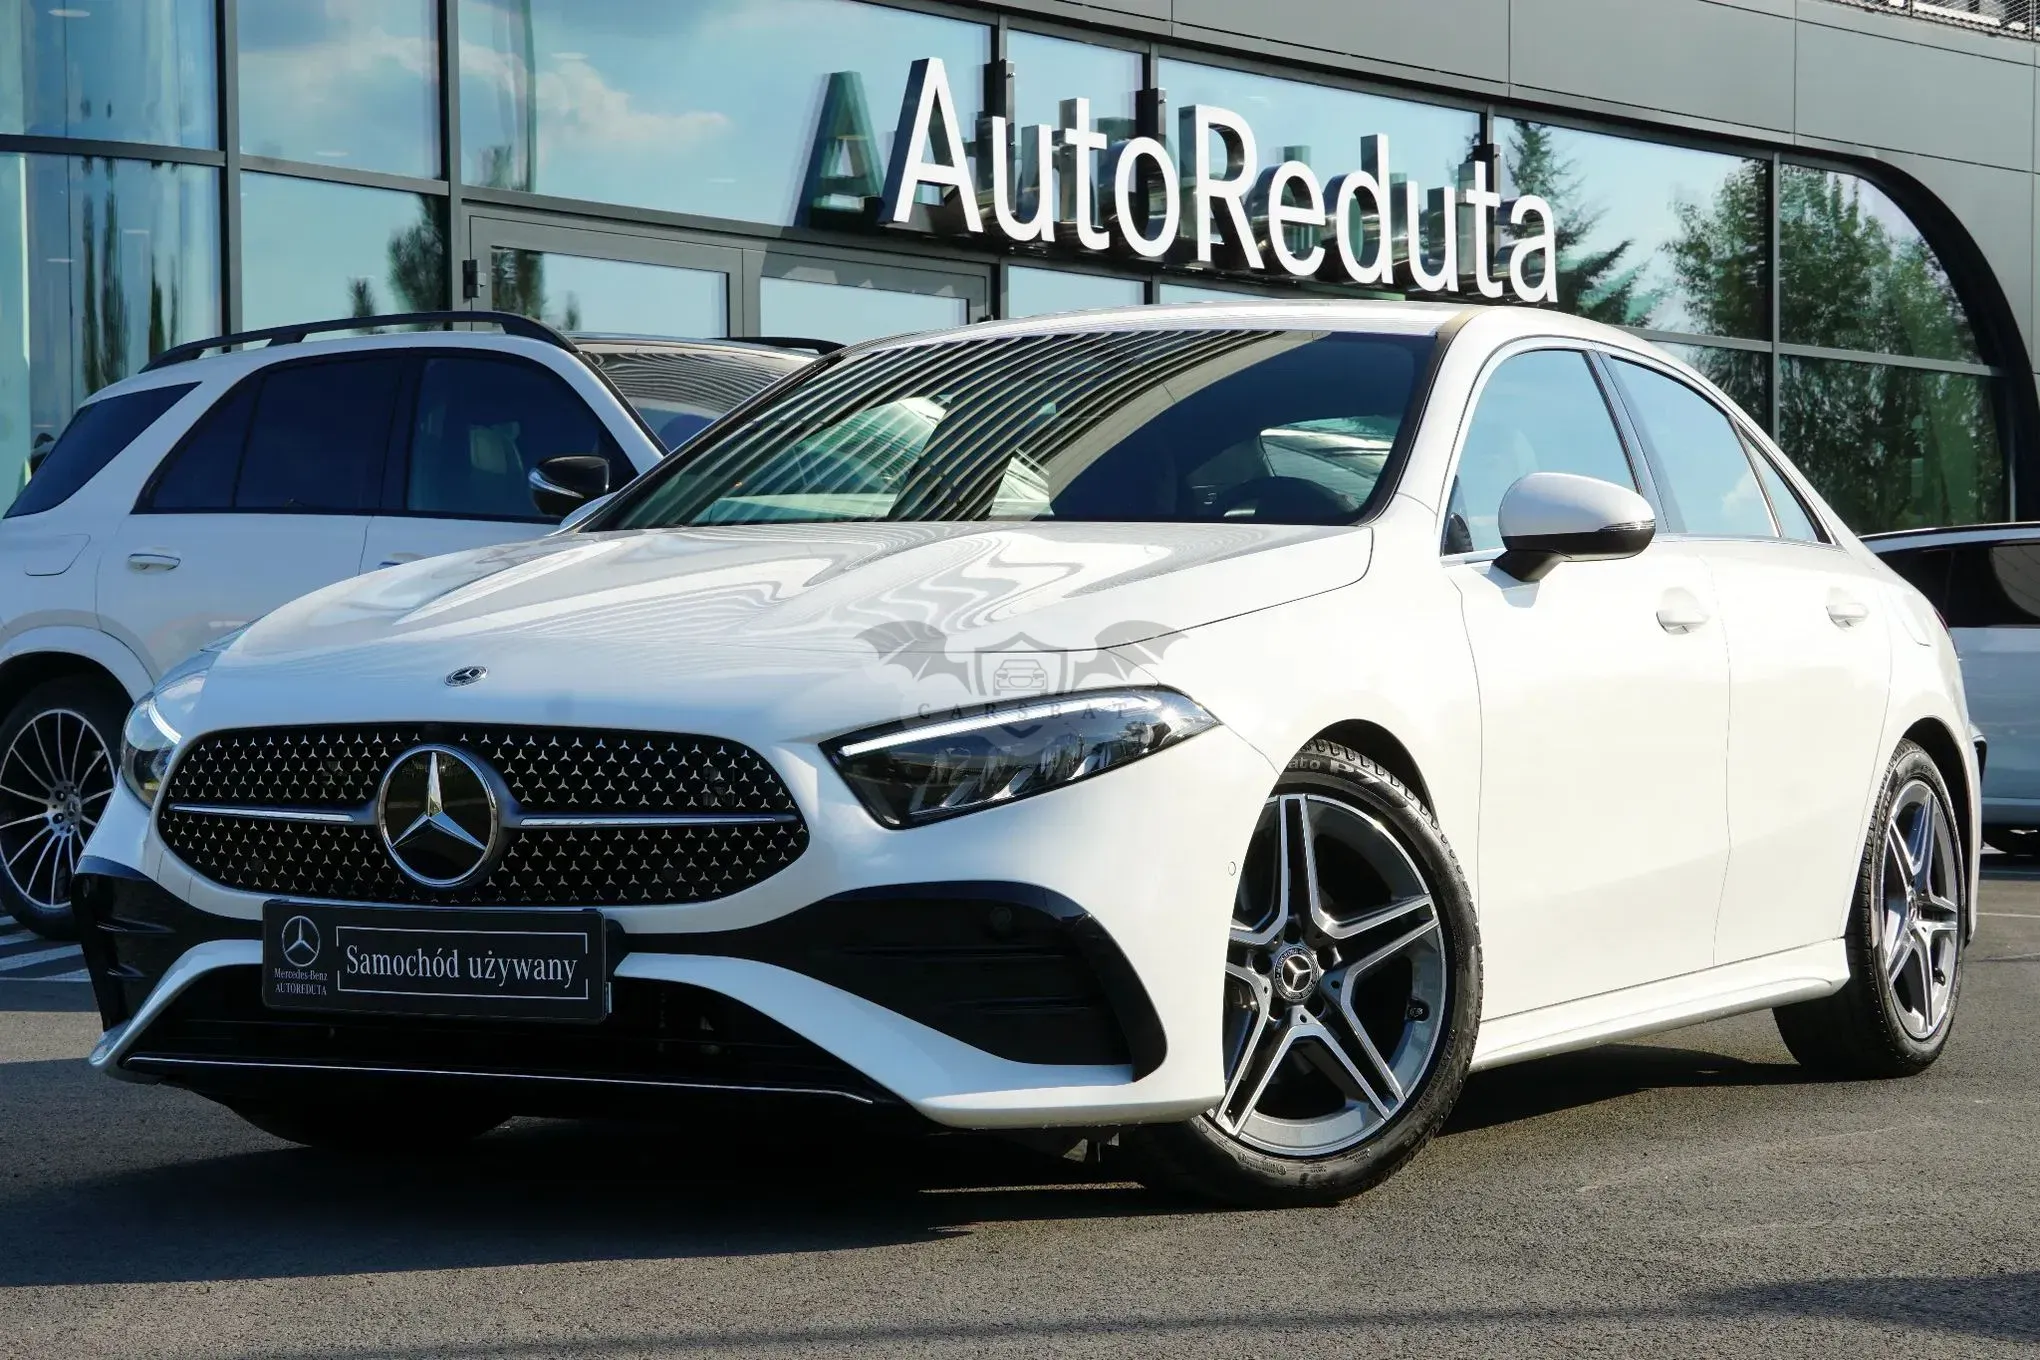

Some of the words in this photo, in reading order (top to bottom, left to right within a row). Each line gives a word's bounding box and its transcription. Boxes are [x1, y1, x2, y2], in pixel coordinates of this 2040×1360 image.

[892, 56, 1559, 303] AutoReduta
[274, 967, 328, 981] Mercedes-Benz
[346, 944, 460, 979] Samochód
[467, 950, 578, 989] używany
[275, 982, 327, 996] AUTOREDUTA
